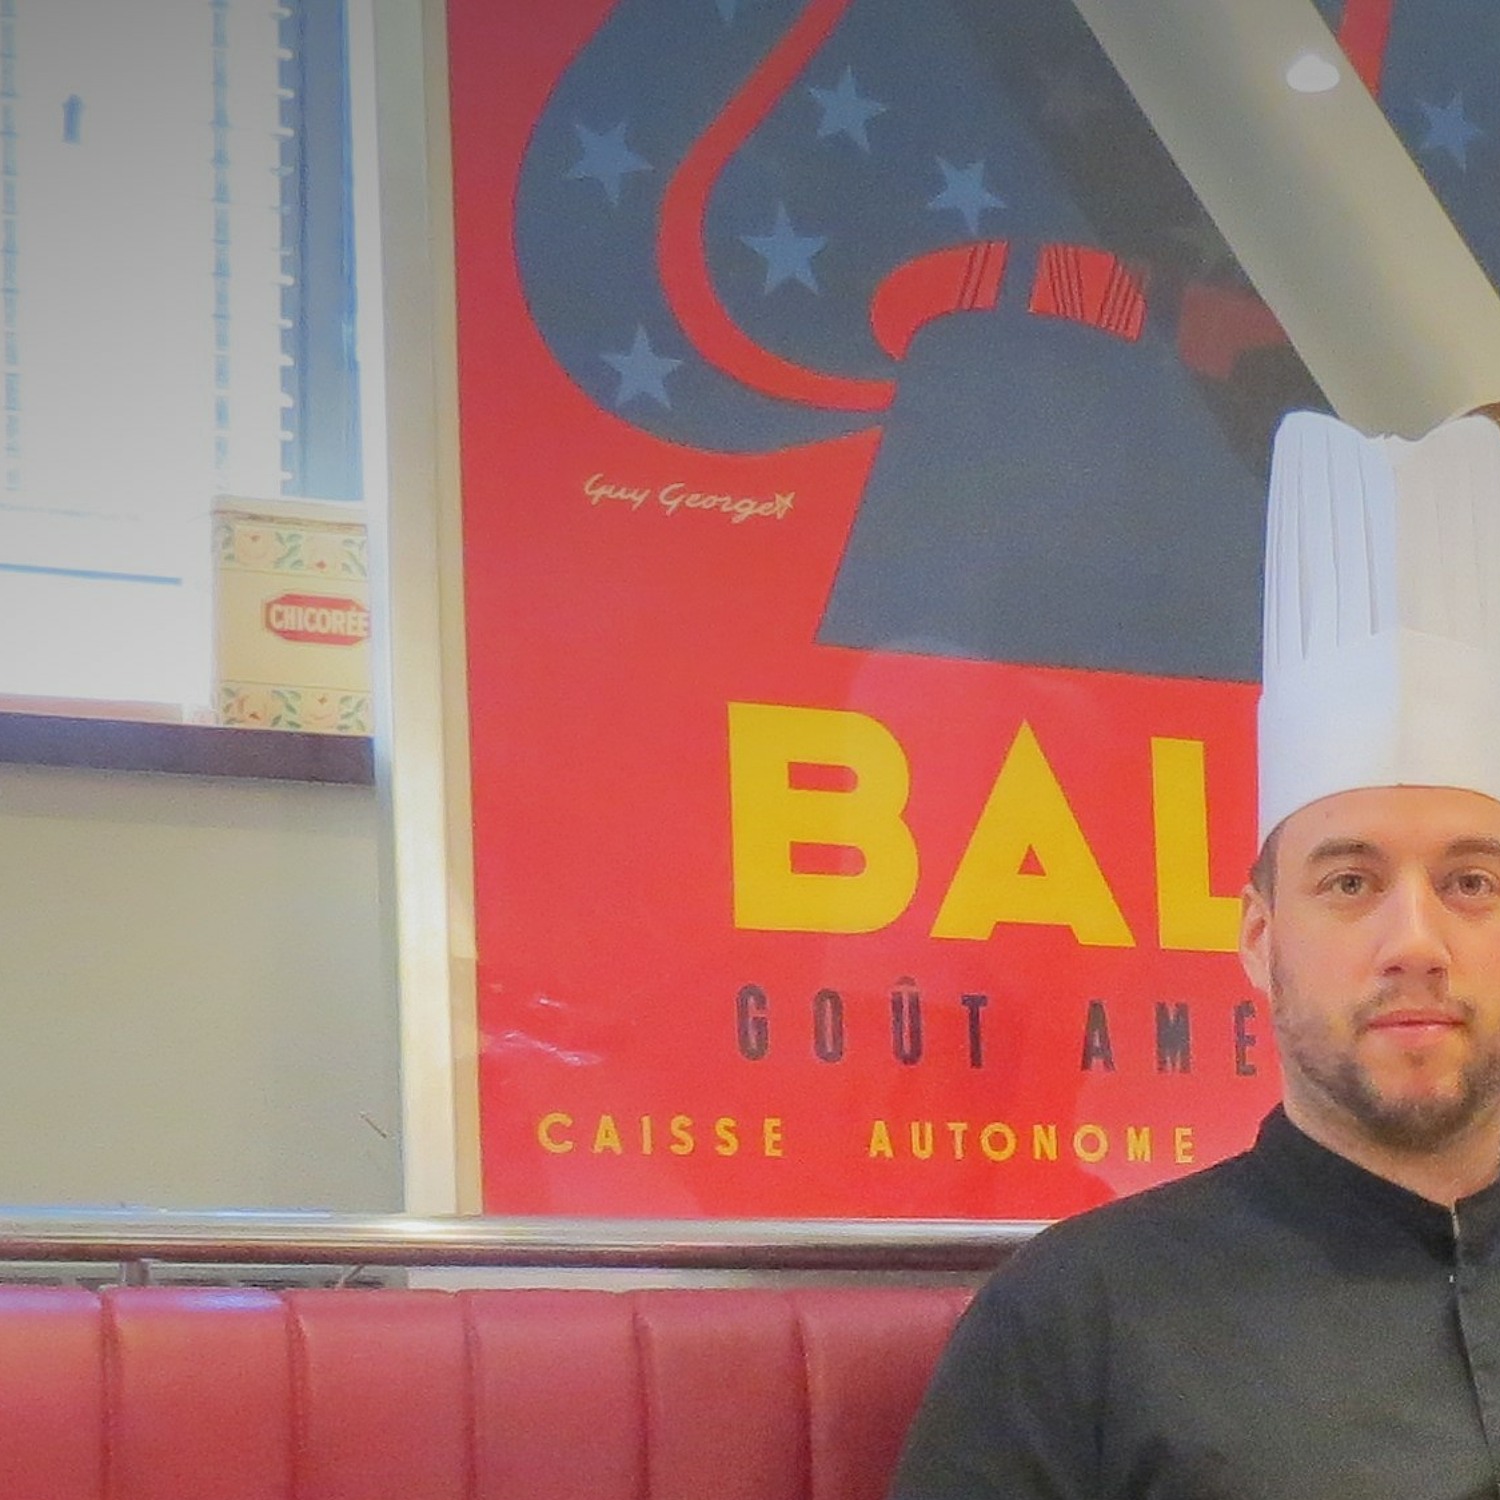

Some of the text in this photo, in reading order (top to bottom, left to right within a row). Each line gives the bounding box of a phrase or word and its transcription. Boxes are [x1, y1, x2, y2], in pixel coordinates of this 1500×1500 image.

[584, 473, 650, 511] Guy
[736, 975, 989, 1068] GOÛT
[537, 1112, 783, 1157] CAISSE
[868, 1120, 1195, 1163] AUTONOME
